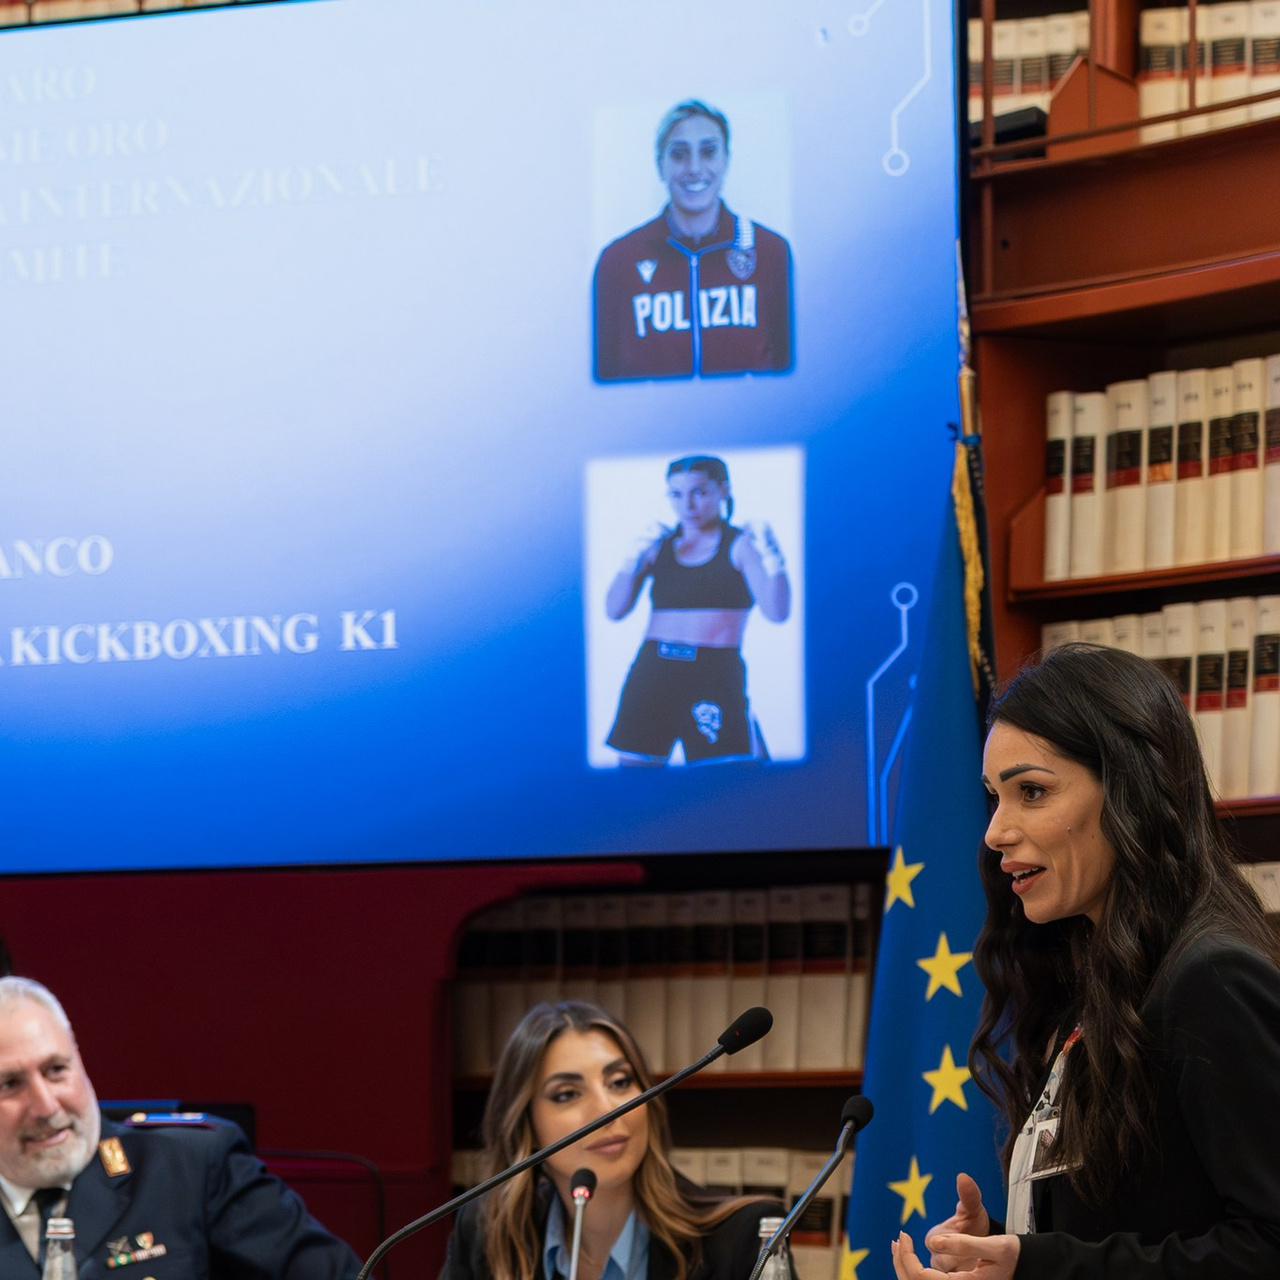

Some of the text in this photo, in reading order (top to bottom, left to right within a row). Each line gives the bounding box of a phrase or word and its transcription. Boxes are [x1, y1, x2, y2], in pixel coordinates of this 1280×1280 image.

[632, 284, 758, 338] POLIZIA
[10, 614, 319, 666] KICKBOXING
[339, 610, 399, 651] K1
